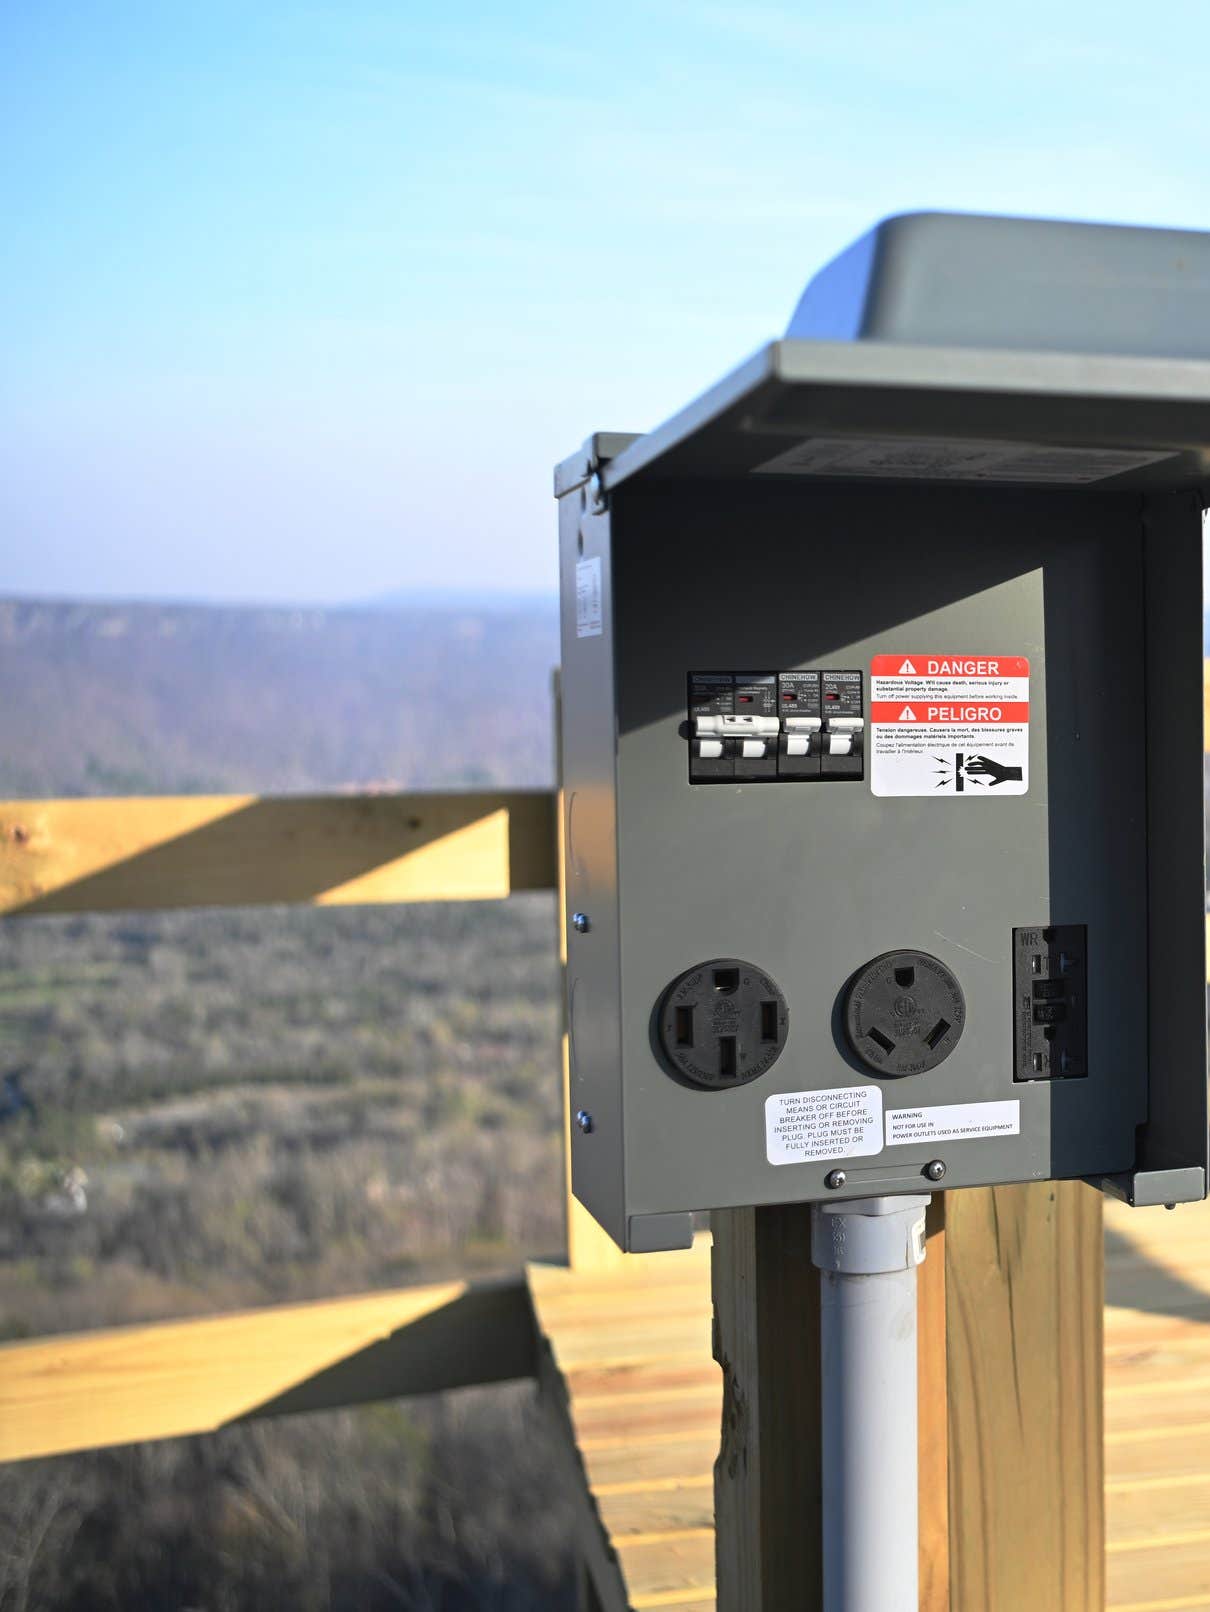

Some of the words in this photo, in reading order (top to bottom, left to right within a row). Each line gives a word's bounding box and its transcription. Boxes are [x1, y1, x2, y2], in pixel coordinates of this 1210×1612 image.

[927, 661, 999, 675] DANGER
[927, 707, 1002, 721] PELIGRO
[1021, 933, 1038, 946] WR
[803, 1091, 867, 1103] DISCONNECTING
[786, 1105, 814, 1114] MEANS
[830, 1101, 860, 1109] CIRCUIT
[780, 1114, 816, 1124] BREAKER
[836, 1109, 868, 1118] BEFORE
[892, 1112, 923, 1120] WARNING
[774, 1123, 816, 1133] INSERTING
[832, 1117, 873, 1127] REMOVING
[831, 1128, 852, 1136] MUST
[786, 1141, 809, 1150] FULLY
[812, 1137, 850, 1147] INSERTED
[805, 1147, 845, 1156] REMOVED.
